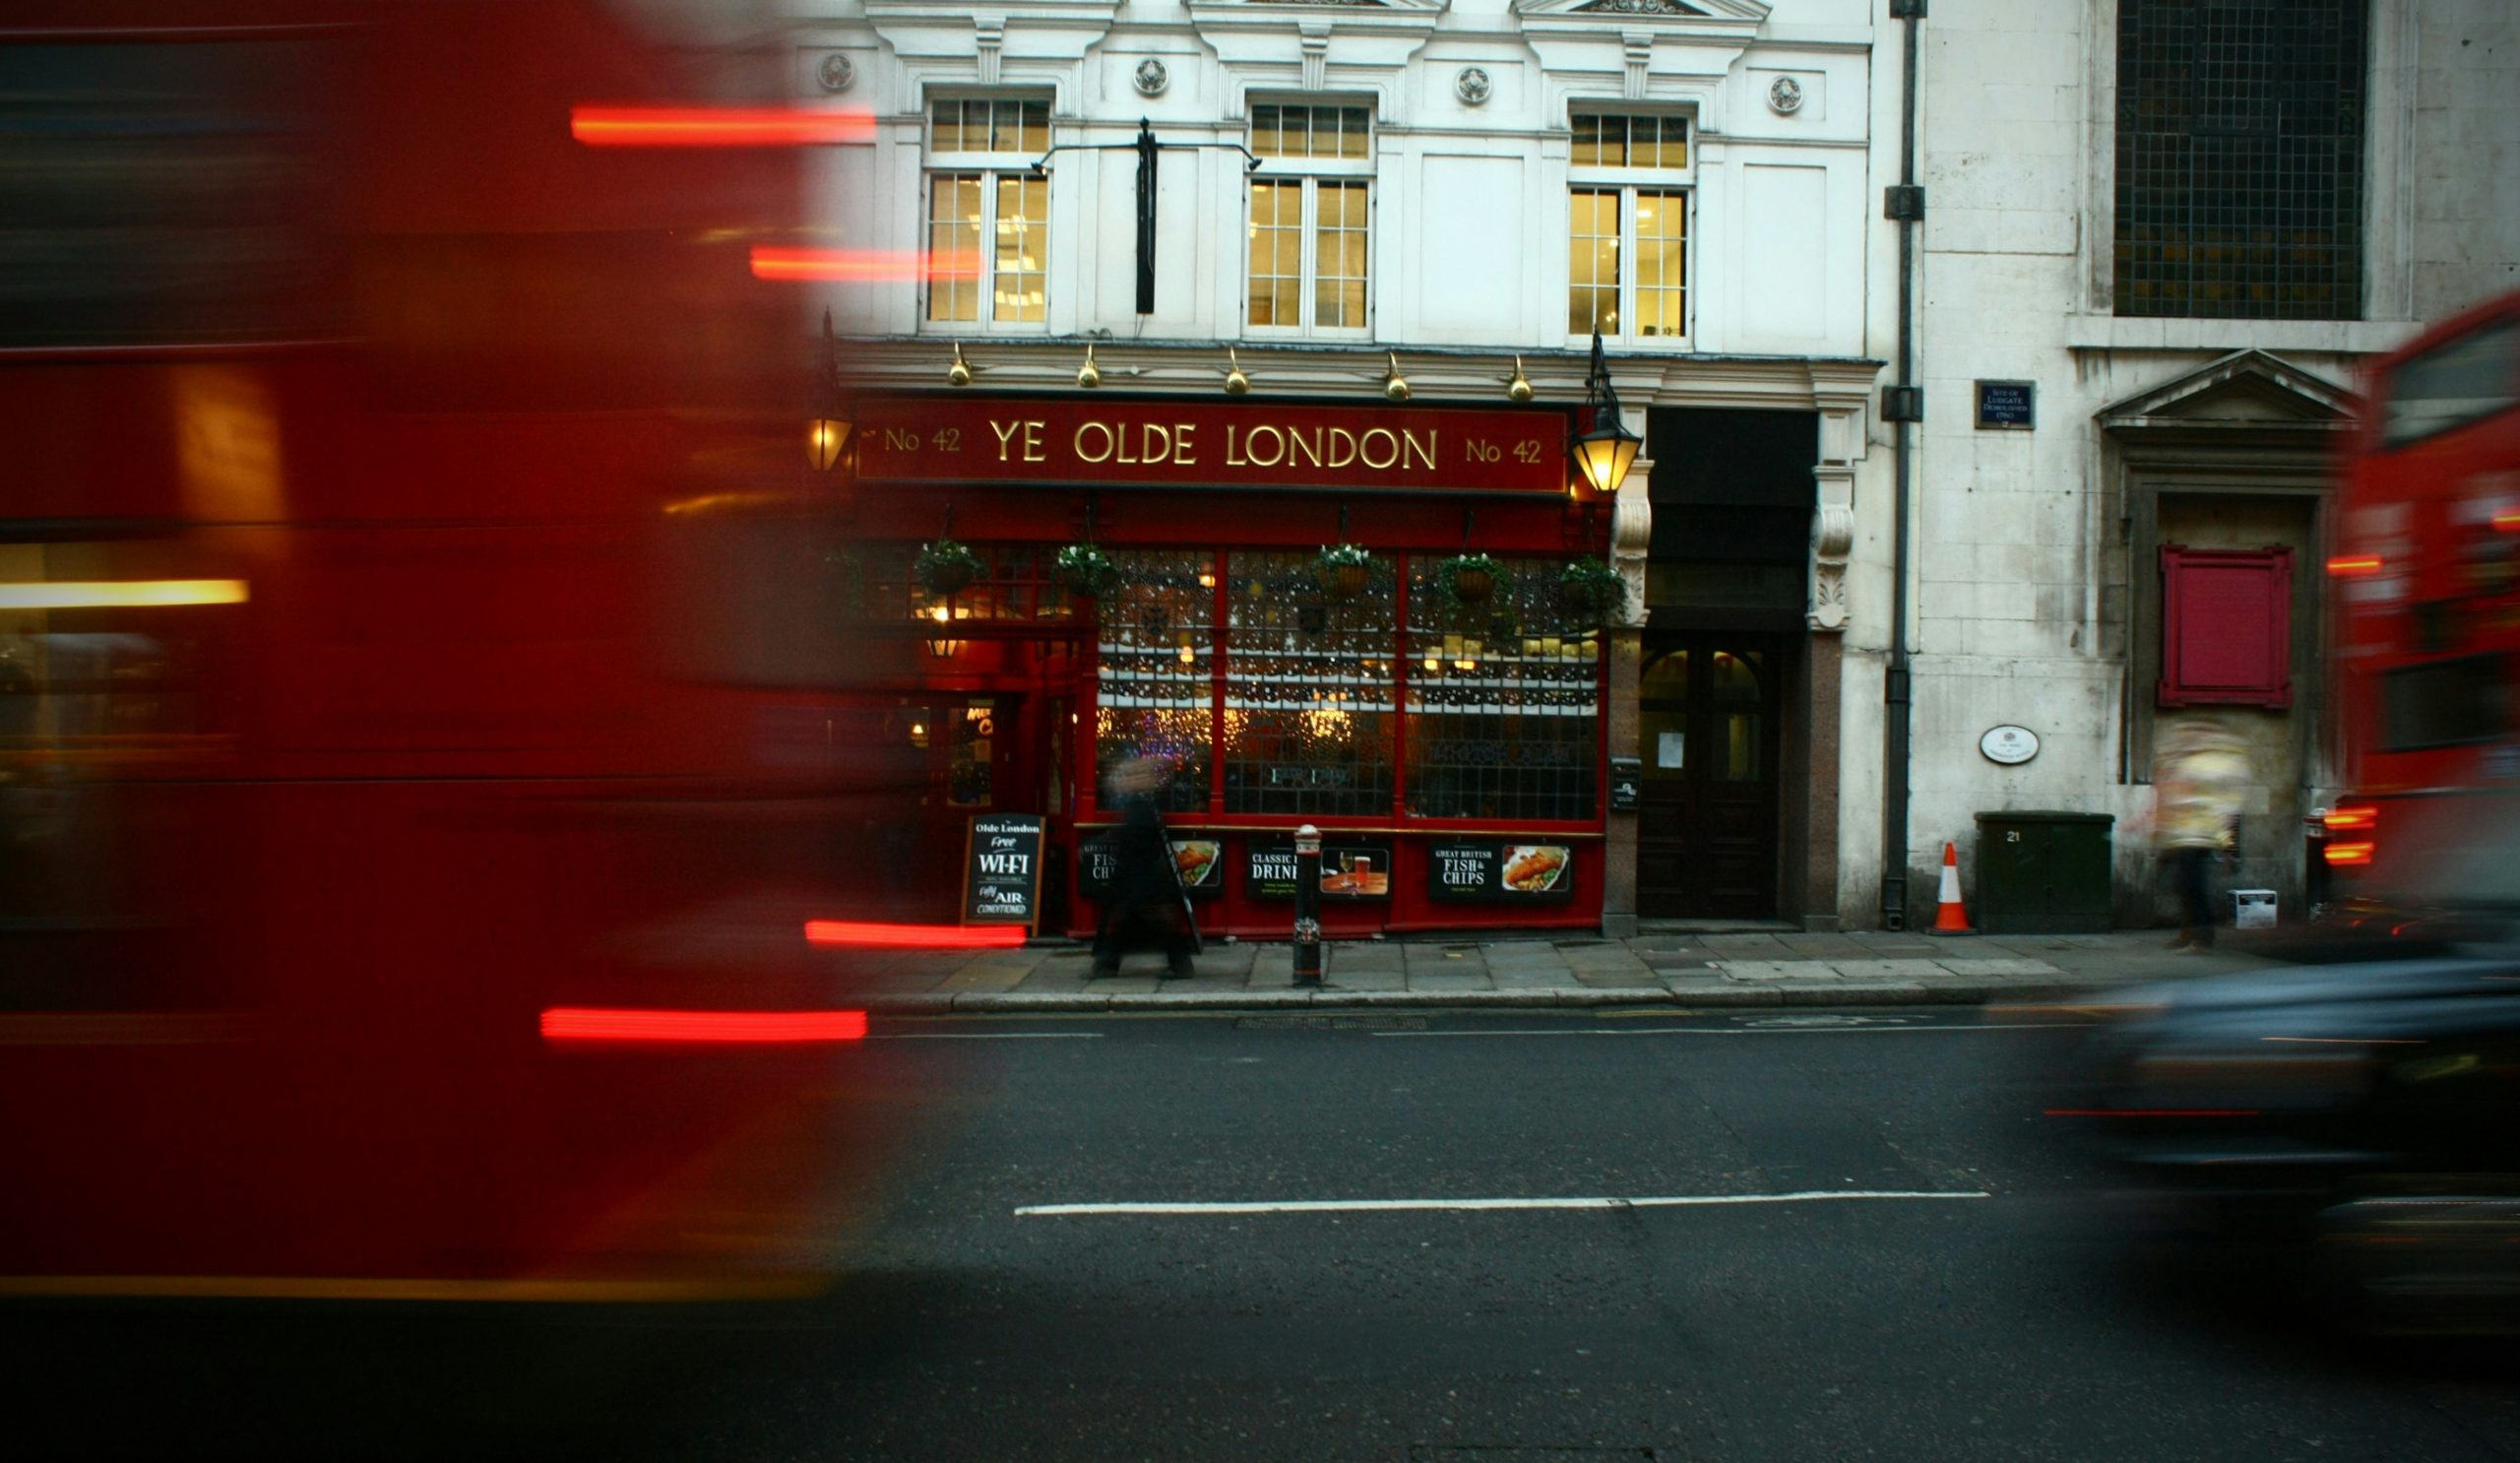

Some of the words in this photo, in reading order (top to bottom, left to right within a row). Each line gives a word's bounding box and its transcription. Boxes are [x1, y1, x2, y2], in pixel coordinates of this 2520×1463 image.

[1987, 395, 2023, 405] LUDGATE
[885, 429, 919, 451] No
[931, 428, 961, 451] 42
[989, 419, 1046, 462] YE
[1074, 421, 1197, 466] OLDE
[1226, 424, 1438, 471] LONDON
[1466, 438, 1501, 463] No
[1512, 439, 1542, 464] 42
[976, 824, 999, 833] Olde
[1001, 824, 1040, 834] London
[990, 836, 1017, 848] Free
[2007, 831, 2020, 842] 21
[1093, 854, 1117, 866] FIS
[1252, 854, 1292, 864] CLASSIC
[1435, 850, 1459, 859] GREAT
[1461, 851, 1492, 859] BRITISH
[978, 854, 1030, 875] WI-FI
[1443, 871, 1485, 885] CHIPS
[976, 904, 1027, 915] CONDITIONED
